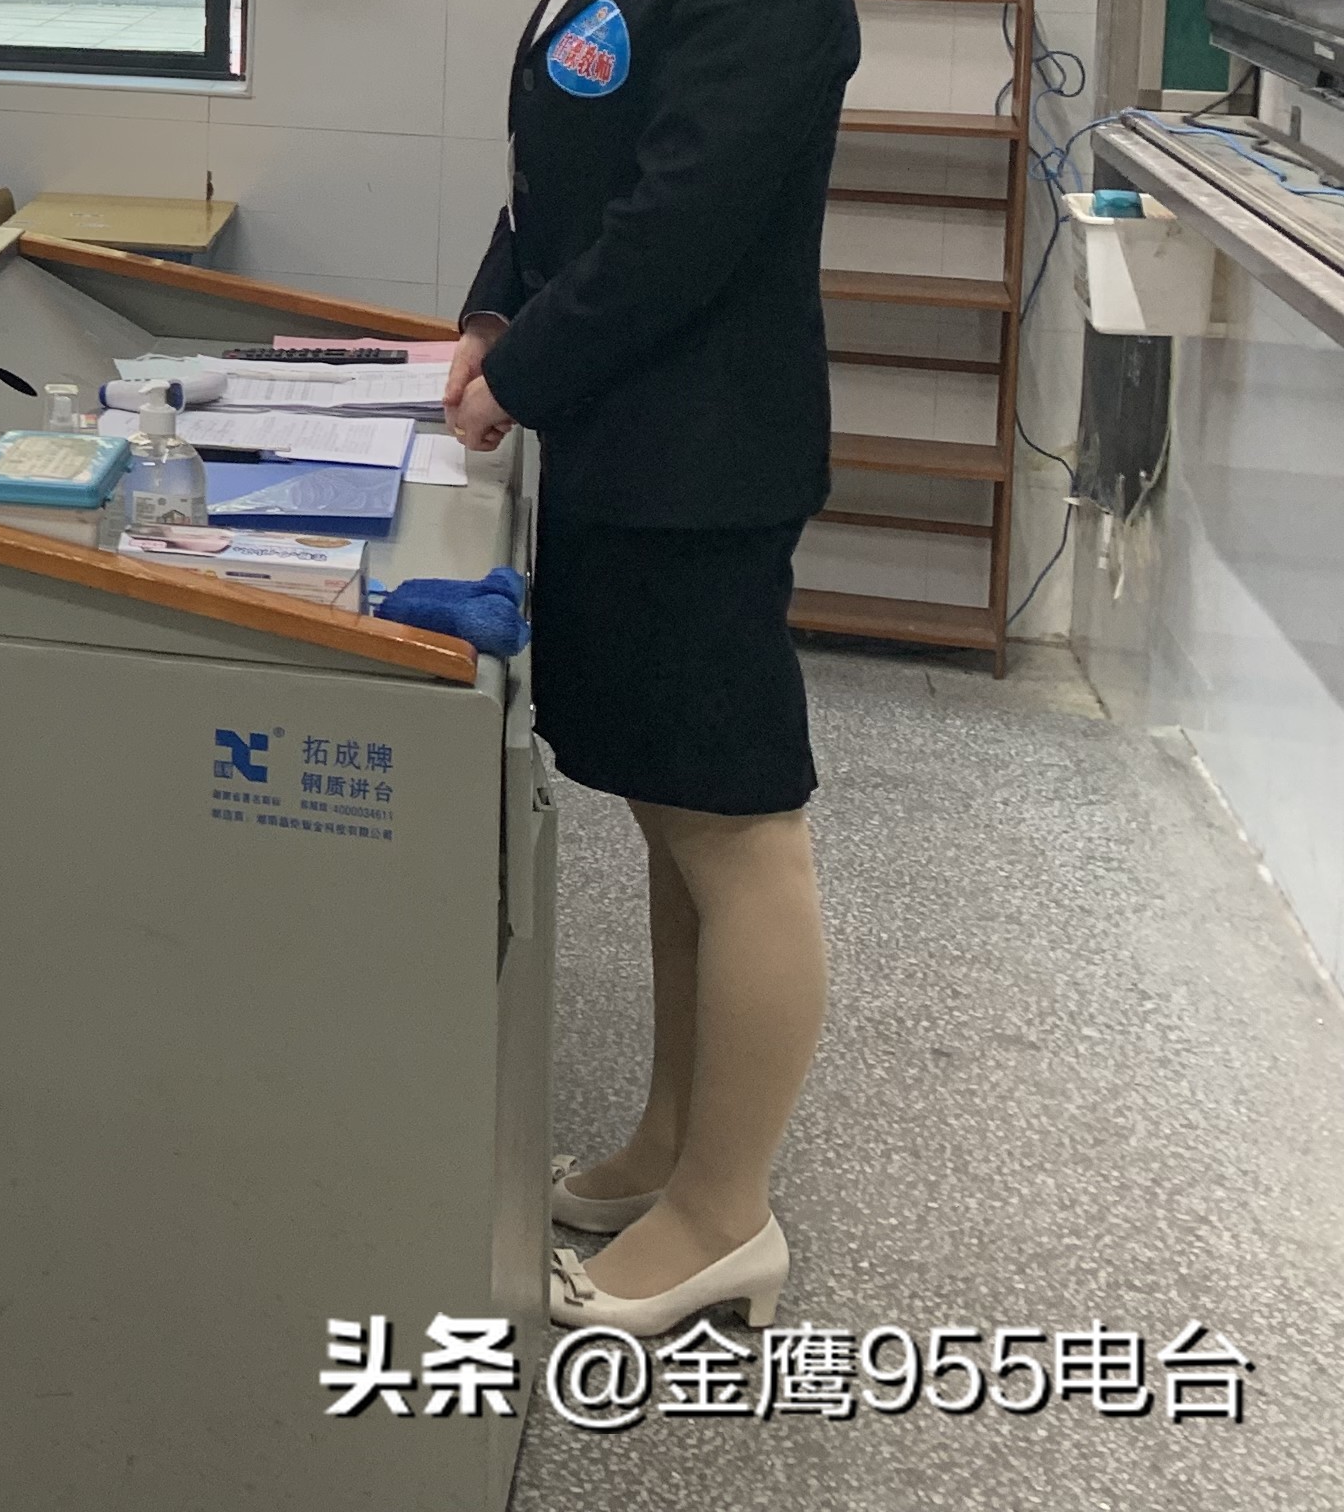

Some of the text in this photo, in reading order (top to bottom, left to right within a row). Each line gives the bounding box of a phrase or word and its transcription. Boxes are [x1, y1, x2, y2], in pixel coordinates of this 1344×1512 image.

[301, 735, 395, 774] 拓成牌
[300, 771, 395, 804] 钢质讲台
